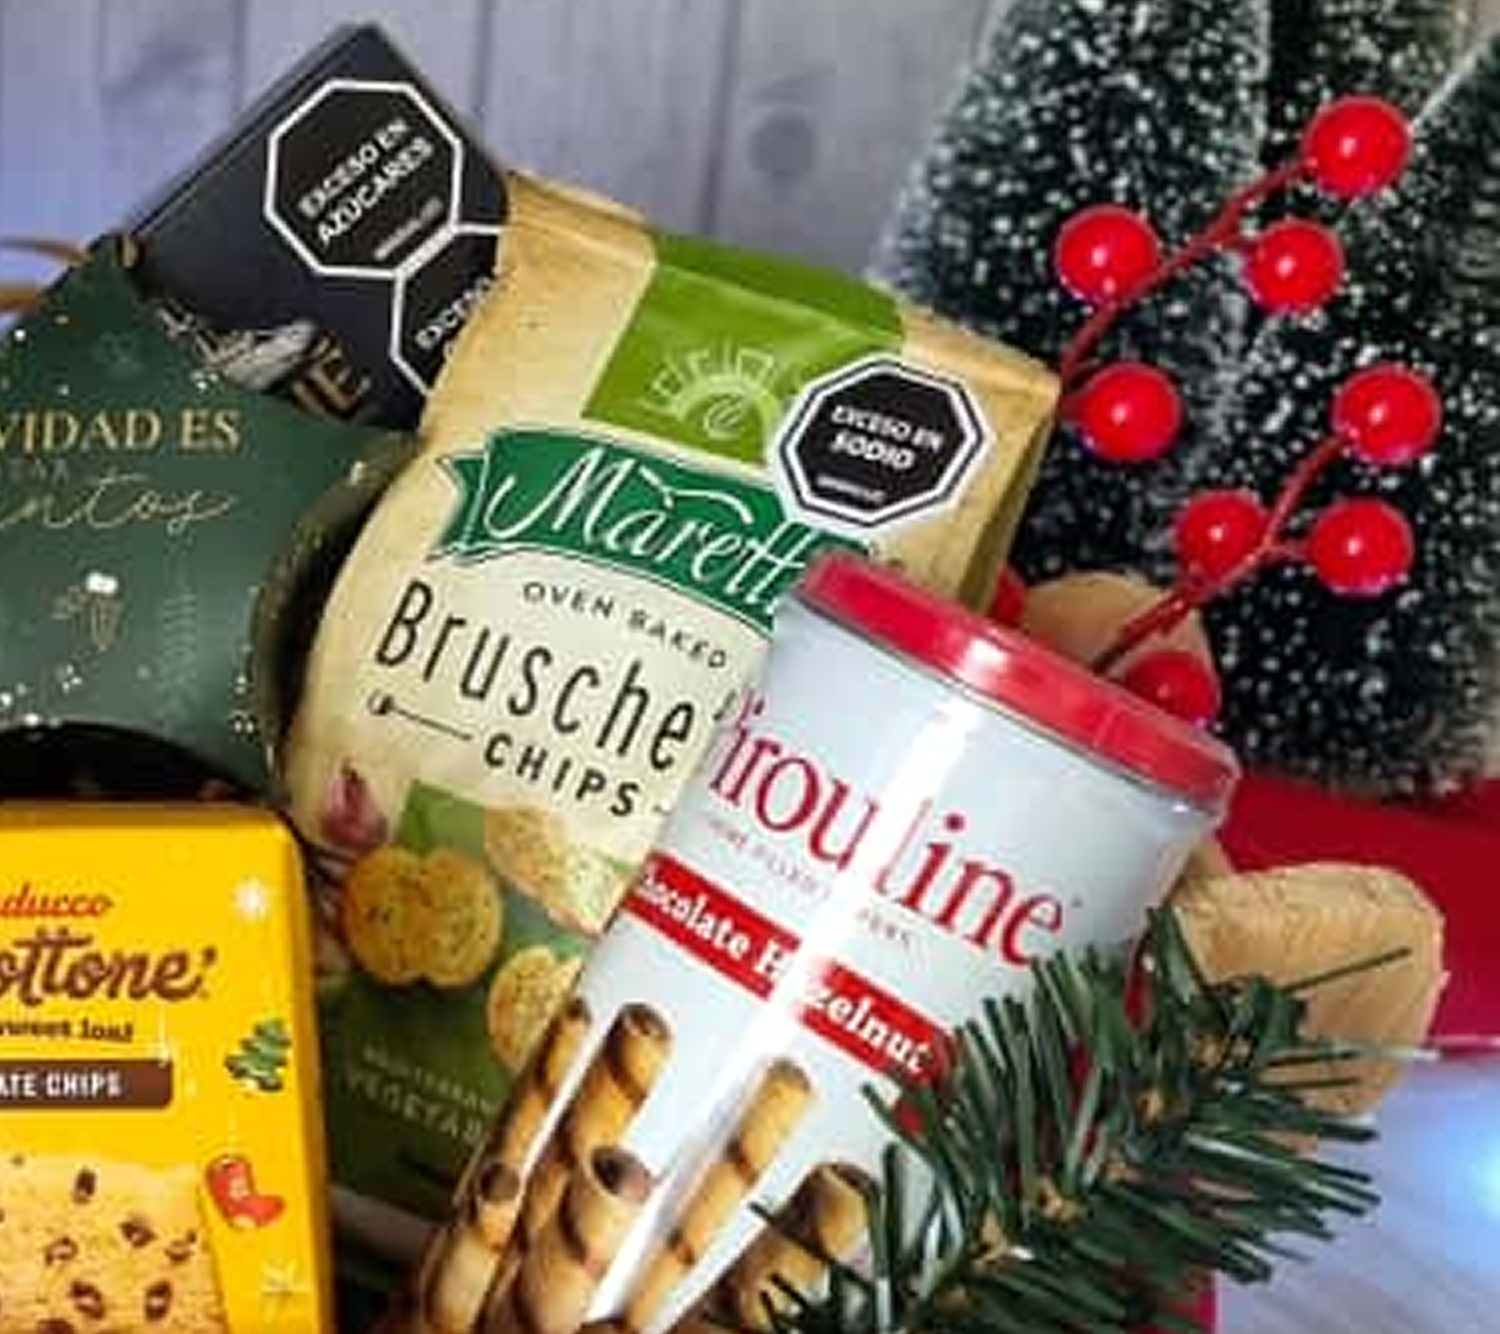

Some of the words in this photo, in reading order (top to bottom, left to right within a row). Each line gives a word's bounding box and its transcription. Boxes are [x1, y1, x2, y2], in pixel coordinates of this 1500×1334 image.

[181, 408, 241, 450] ES
[484, 447, 820, 615] Marett
[522, 581, 616, 619] OVEN
[630, 609, 727, 668] BAKED
[375, 579, 737, 770] Brusche
[485, 731, 643, 818] CHIPS
[46, 1071, 122, 1098] CHIPS
